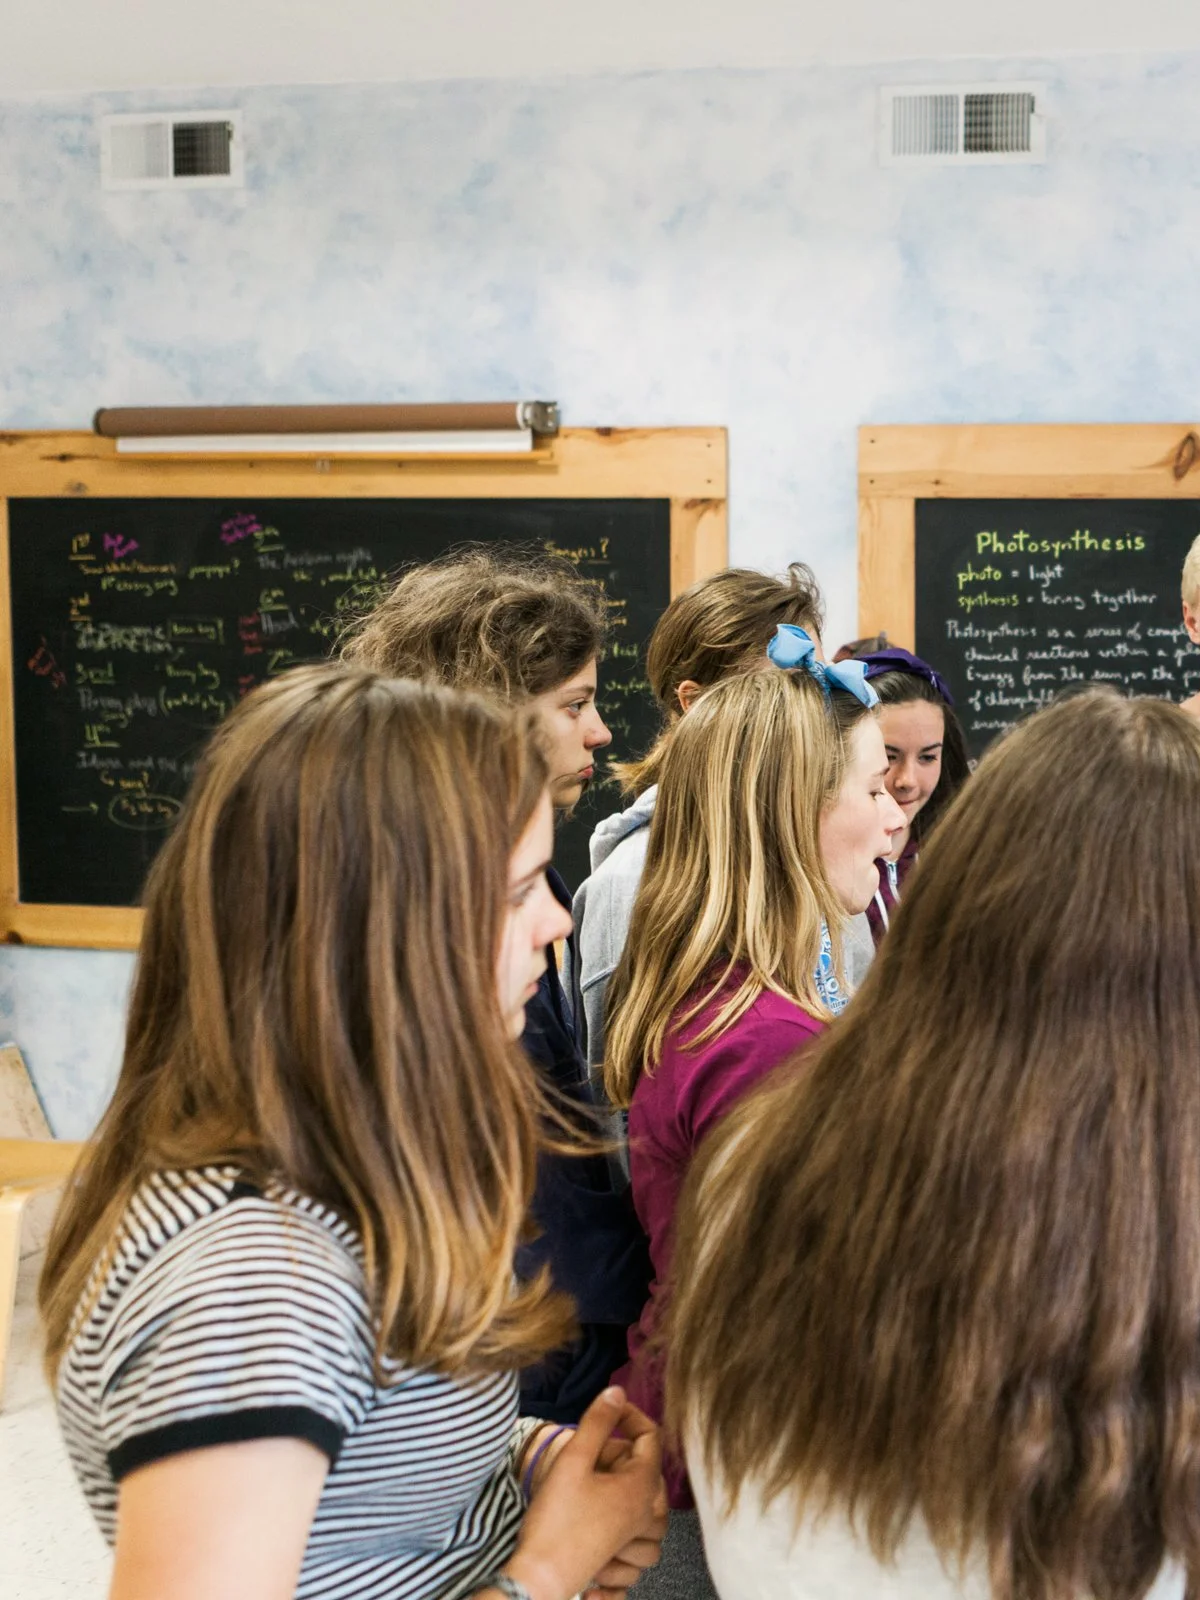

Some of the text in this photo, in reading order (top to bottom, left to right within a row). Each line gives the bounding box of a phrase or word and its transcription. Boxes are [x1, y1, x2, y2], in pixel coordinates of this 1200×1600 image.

[977, 530, 1145, 558] Photosynthesis
[957, 562, 1002, 590] photo
[1029, 564, 1064, 587] light
[958, 591, 1019, 613] synthesis
[1041, 590, 1085, 610] bring
[1091, 588, 1157, 612] together
[947, 620, 1037, 643] Photosynthesis
[1127, 622, 1142, 640] of
[1022, 664, 1056, 686] from
